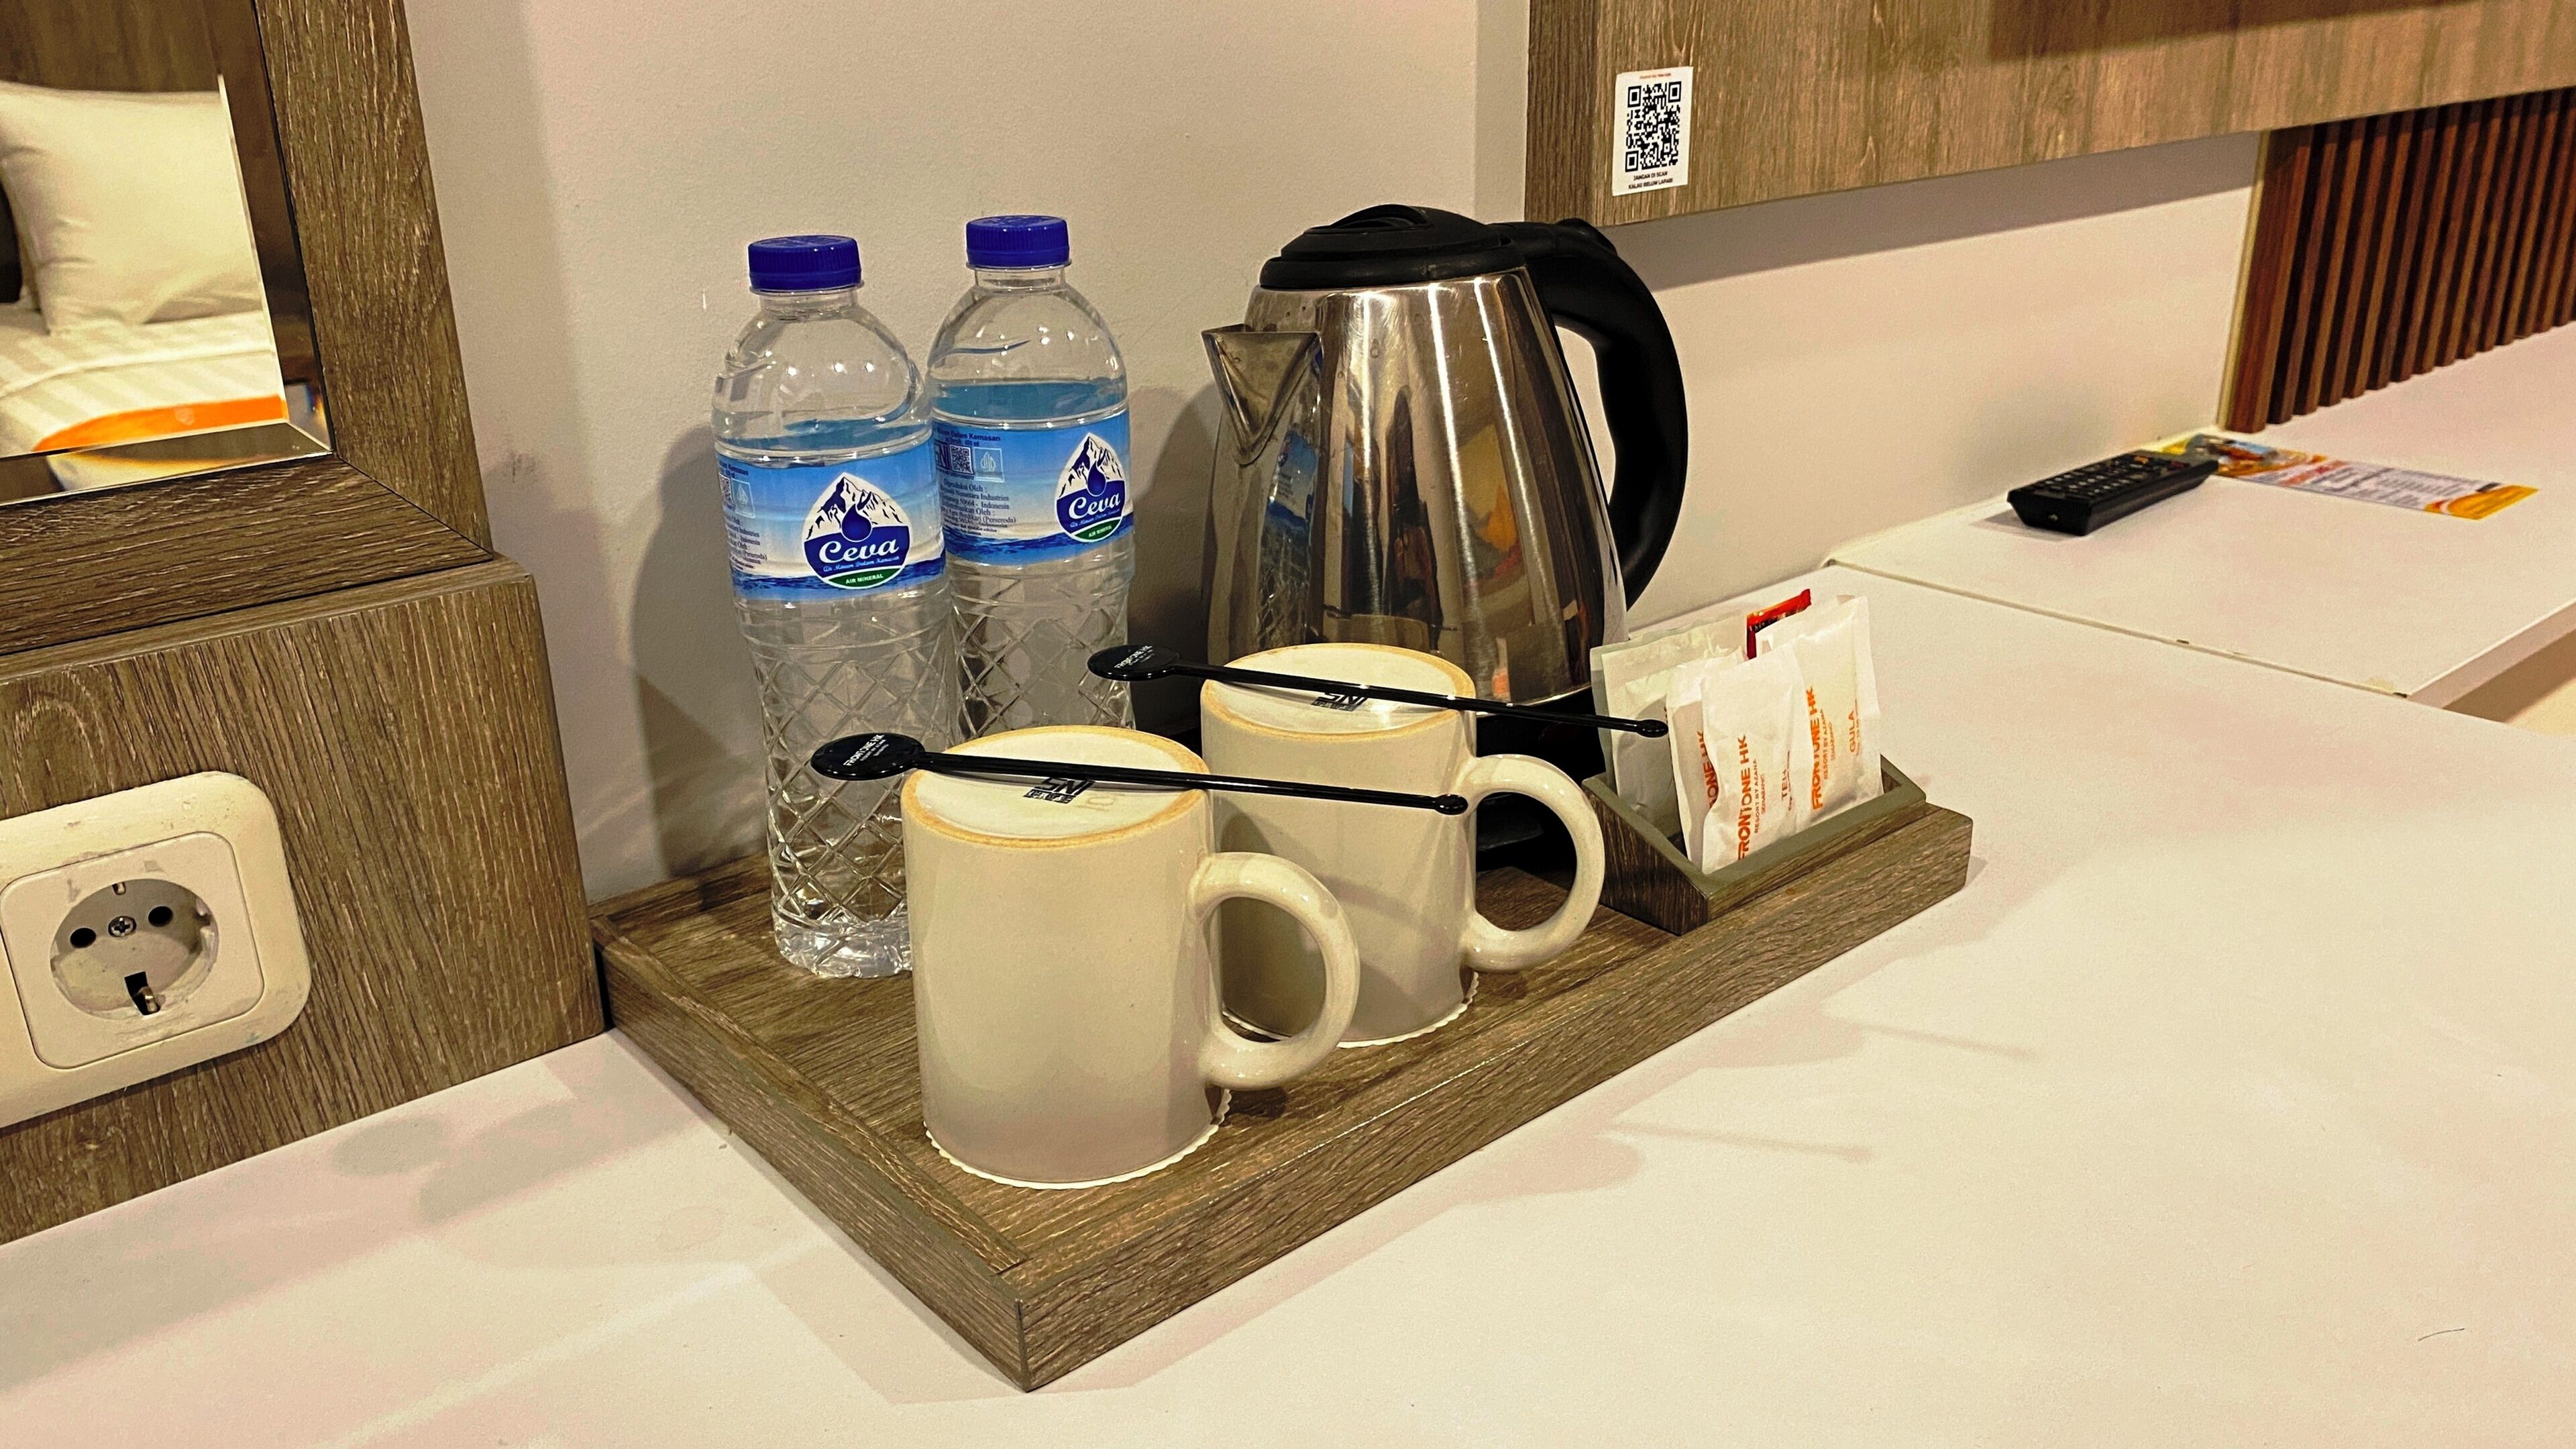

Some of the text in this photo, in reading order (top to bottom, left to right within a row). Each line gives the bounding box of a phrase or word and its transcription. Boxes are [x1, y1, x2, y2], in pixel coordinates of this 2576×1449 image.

[981, 494, 1010, 502] Industries
[1069, 493, 1120, 520] Ceva
[819, 539, 900, 564] Ceva
[857, 573, 884, 582] MINERAL
[1806, 687, 1817, 716] HK
[1737, 734, 1750, 764] HK
[1034, 776, 1095, 797] SNI
[1754, 787, 1759, 799] BY
